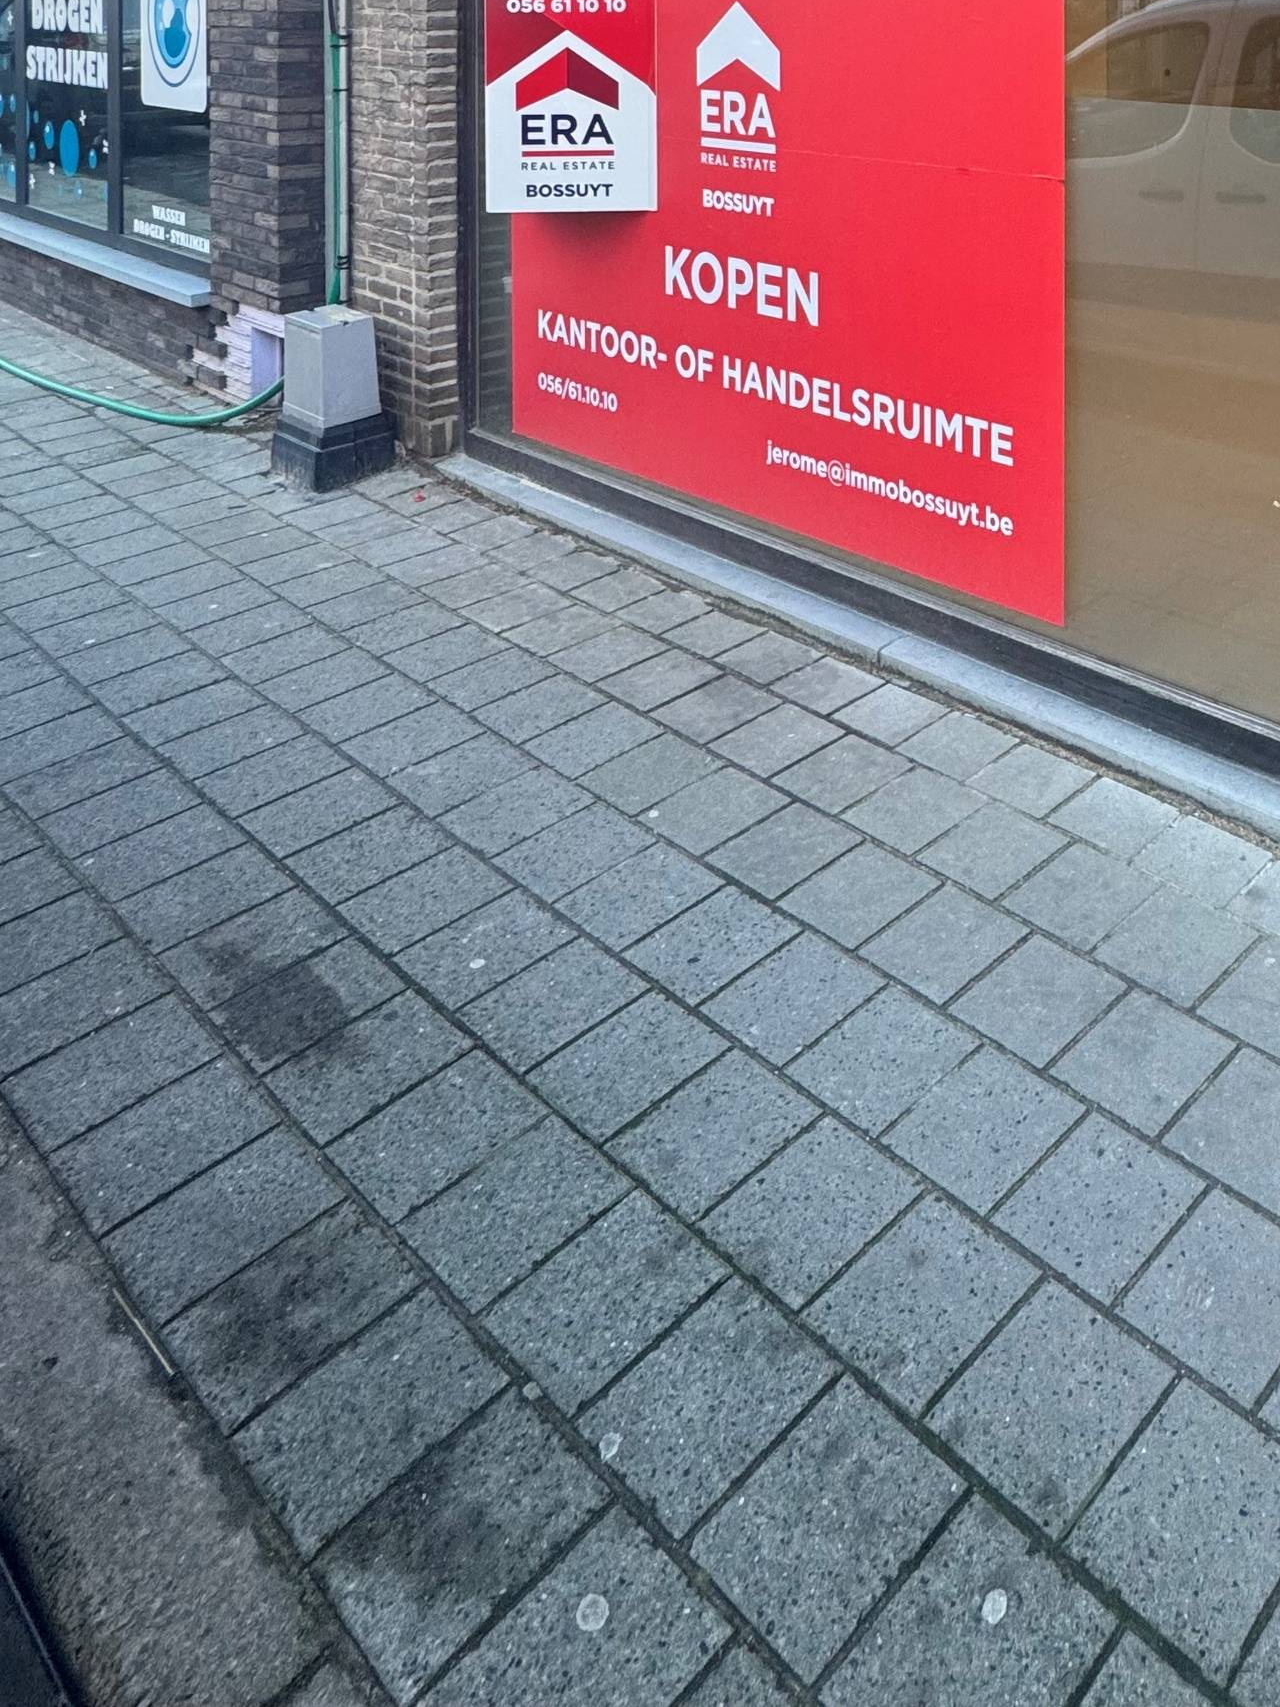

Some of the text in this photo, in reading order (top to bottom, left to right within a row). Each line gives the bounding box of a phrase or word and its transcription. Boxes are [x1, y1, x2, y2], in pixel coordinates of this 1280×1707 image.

[26, 45, 108, 89] STRIJKEN
[521, 113, 614, 146] ERA
[701, 90, 775, 137] ERA
[521, 160, 615, 172] REAL ESTATE
[701, 153, 775, 171] REAL ESTATE
[526, 183, 613, 198] BOSSUYT
[703, 189, 774, 216] BOSSUYT
[666, 246, 818, 326] KOPEN
[537, 373, 617, 411] 056/61.10.10
[538, 310, 1013, 468] KANTOOR- OF HANDELSRUIMTE
[766, 439, 1013, 535] jerome@immobossuyt.be
